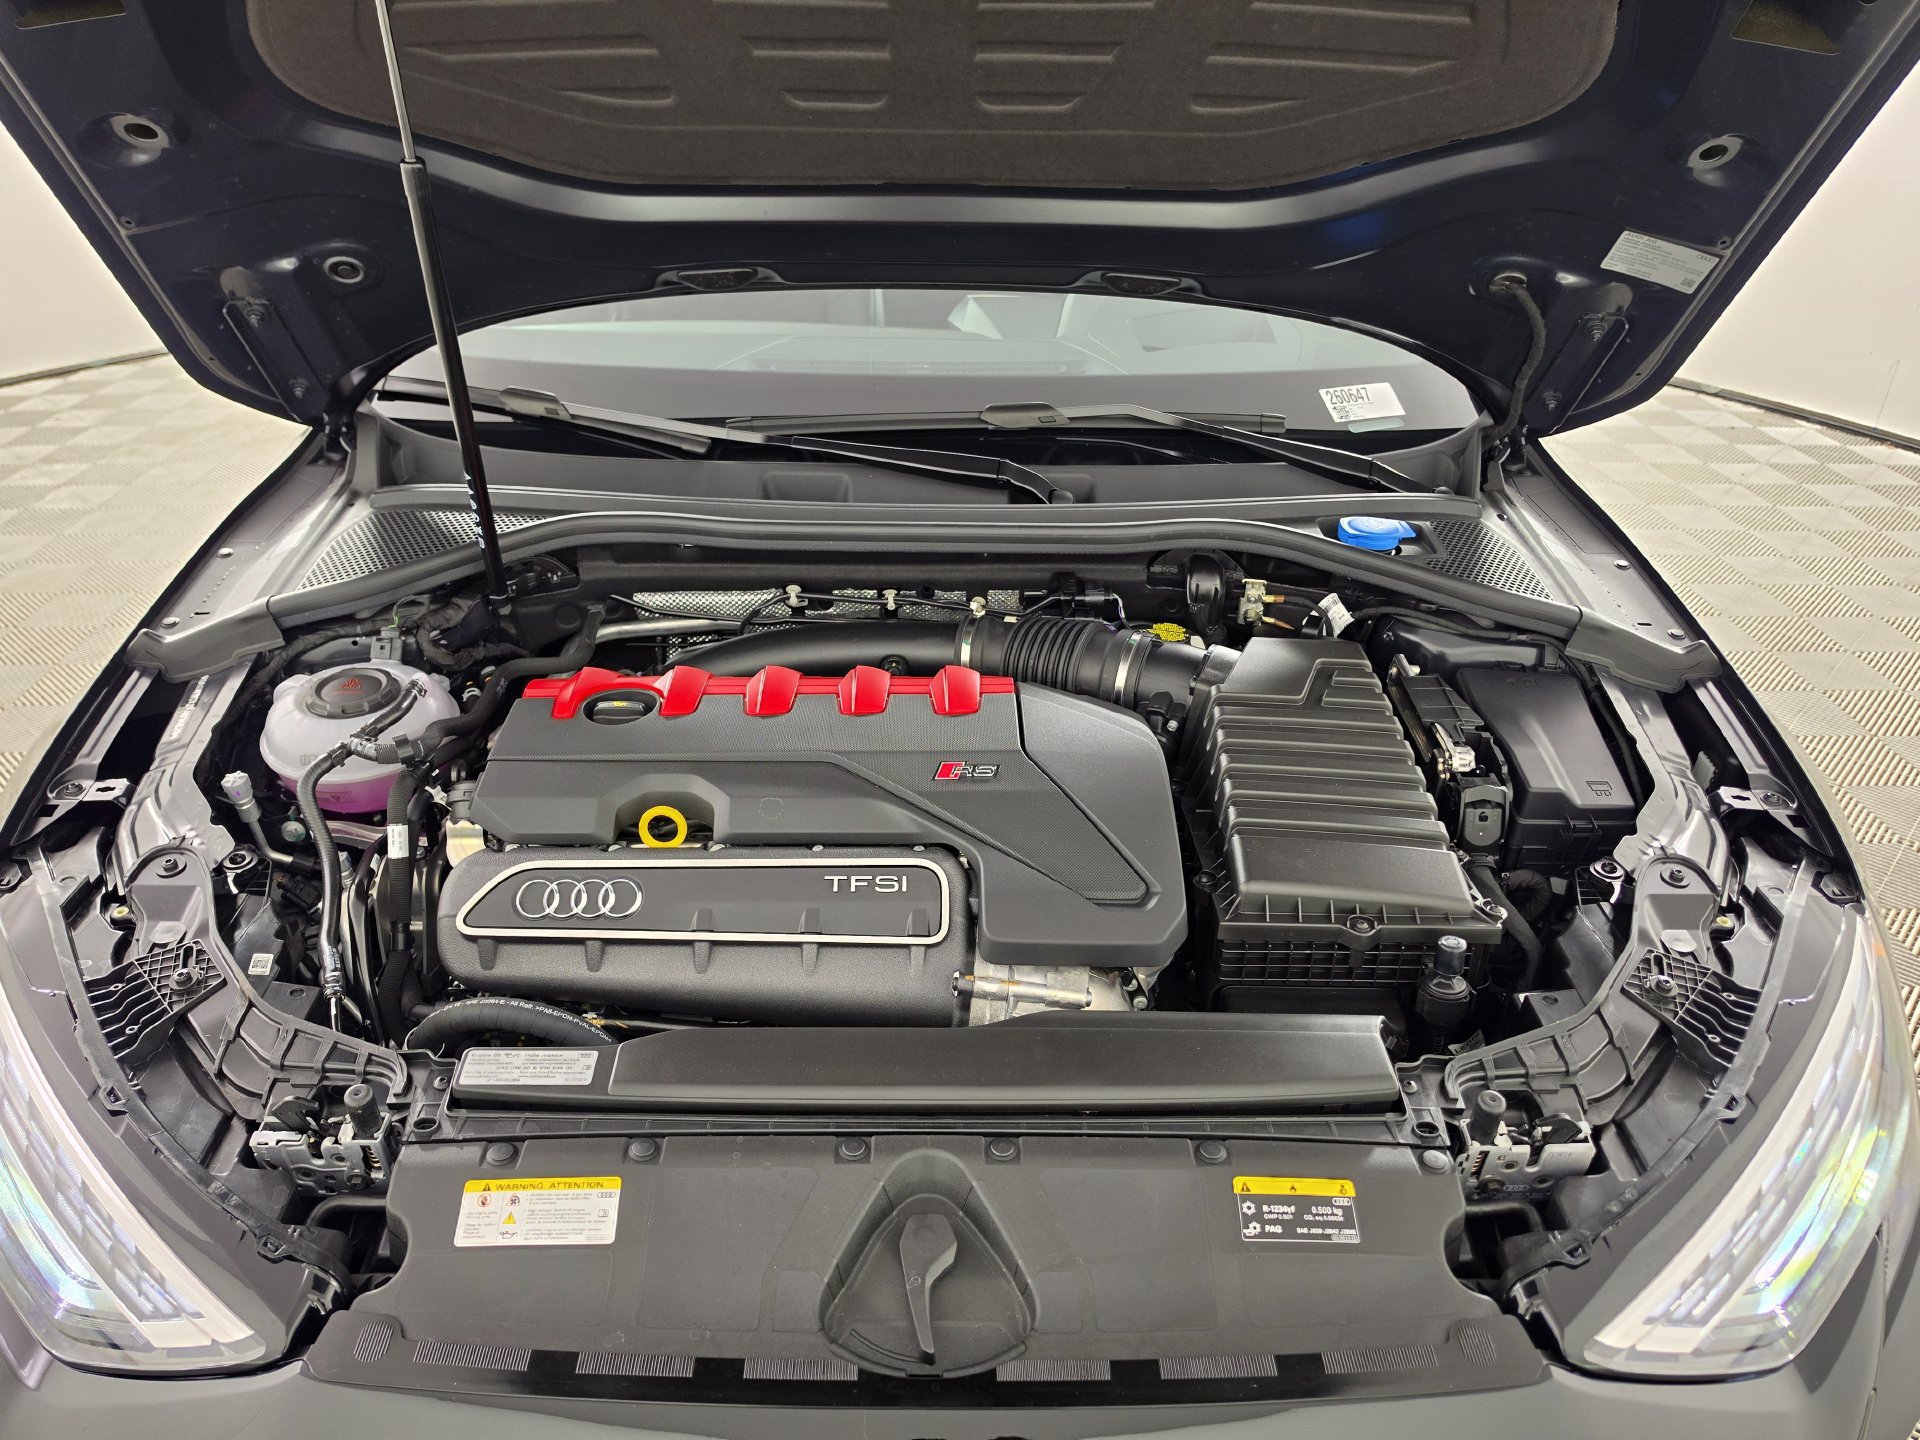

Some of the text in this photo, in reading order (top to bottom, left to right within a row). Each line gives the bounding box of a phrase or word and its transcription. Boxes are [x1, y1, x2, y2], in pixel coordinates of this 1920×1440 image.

[1625, 233, 1644, 241] AUDI
[1325, 387, 1371, 405] 260647
[945, 763, 999, 778] RS
[824, 875, 907, 892] TFSI
[495, 1181, 604, 1191] WARNING ATTENTION
[1332, 1207, 1343, 1216] kg
[1265, 1225, 1282, 1233] PAG
